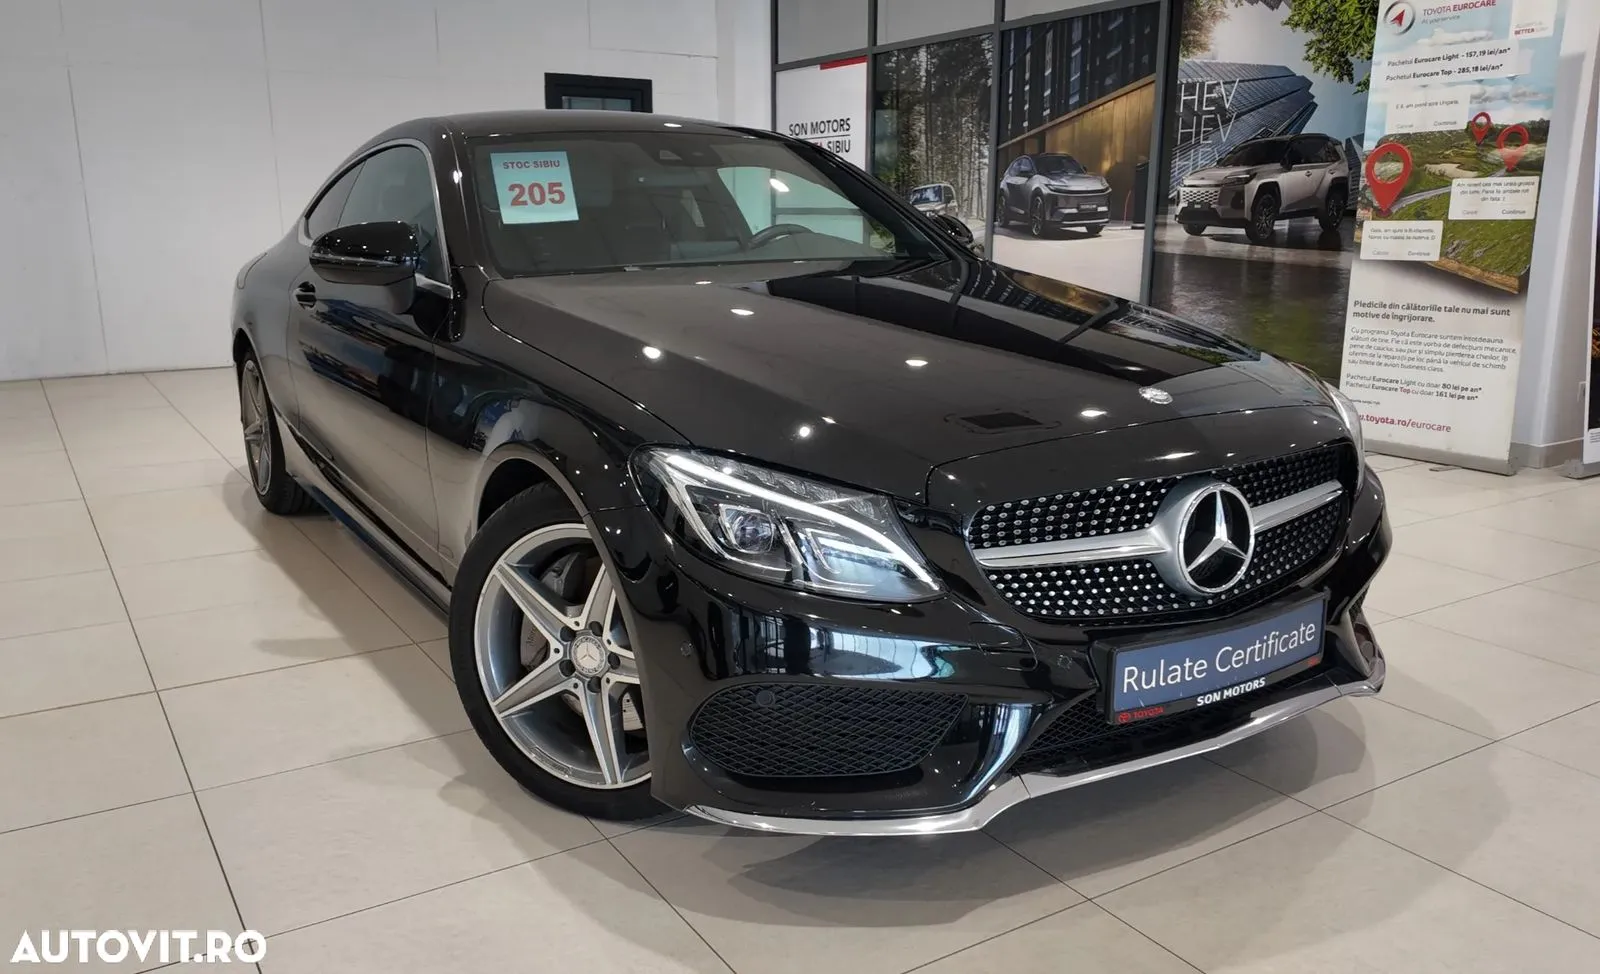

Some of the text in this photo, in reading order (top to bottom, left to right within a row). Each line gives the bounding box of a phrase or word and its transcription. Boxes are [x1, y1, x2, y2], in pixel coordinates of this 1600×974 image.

[1423, 0, 1496, 16] TOYOTA EUROCARE
[1442, 53, 1459, 62] Light
[1466, 50, 1486, 58] 157,19
[1412, 70, 1440, 78] Eurocare
[1180, 78, 1240, 112] HEV
[789, 118, 850, 136] SON MOTORS
[1177, 112, 1237, 144] HEV
[827, 140, 850, 153] SIBIU
[503, 160, 560, 169] STOC SIBIU
[508, 182, 565, 207] 205
[1354, 300, 1387, 308] Piedicile
[1490, 308, 1510, 316] sunt
[1372, 384, 1398, 392] Eurocare
[1373, 376, 1399, 384] Eurocare
[1123, 622, 1316, 694] Rulate Certificate
[1196, 677, 1266, 707] SON MOTORS
[1134, 706, 1164, 718] TOYOTA
